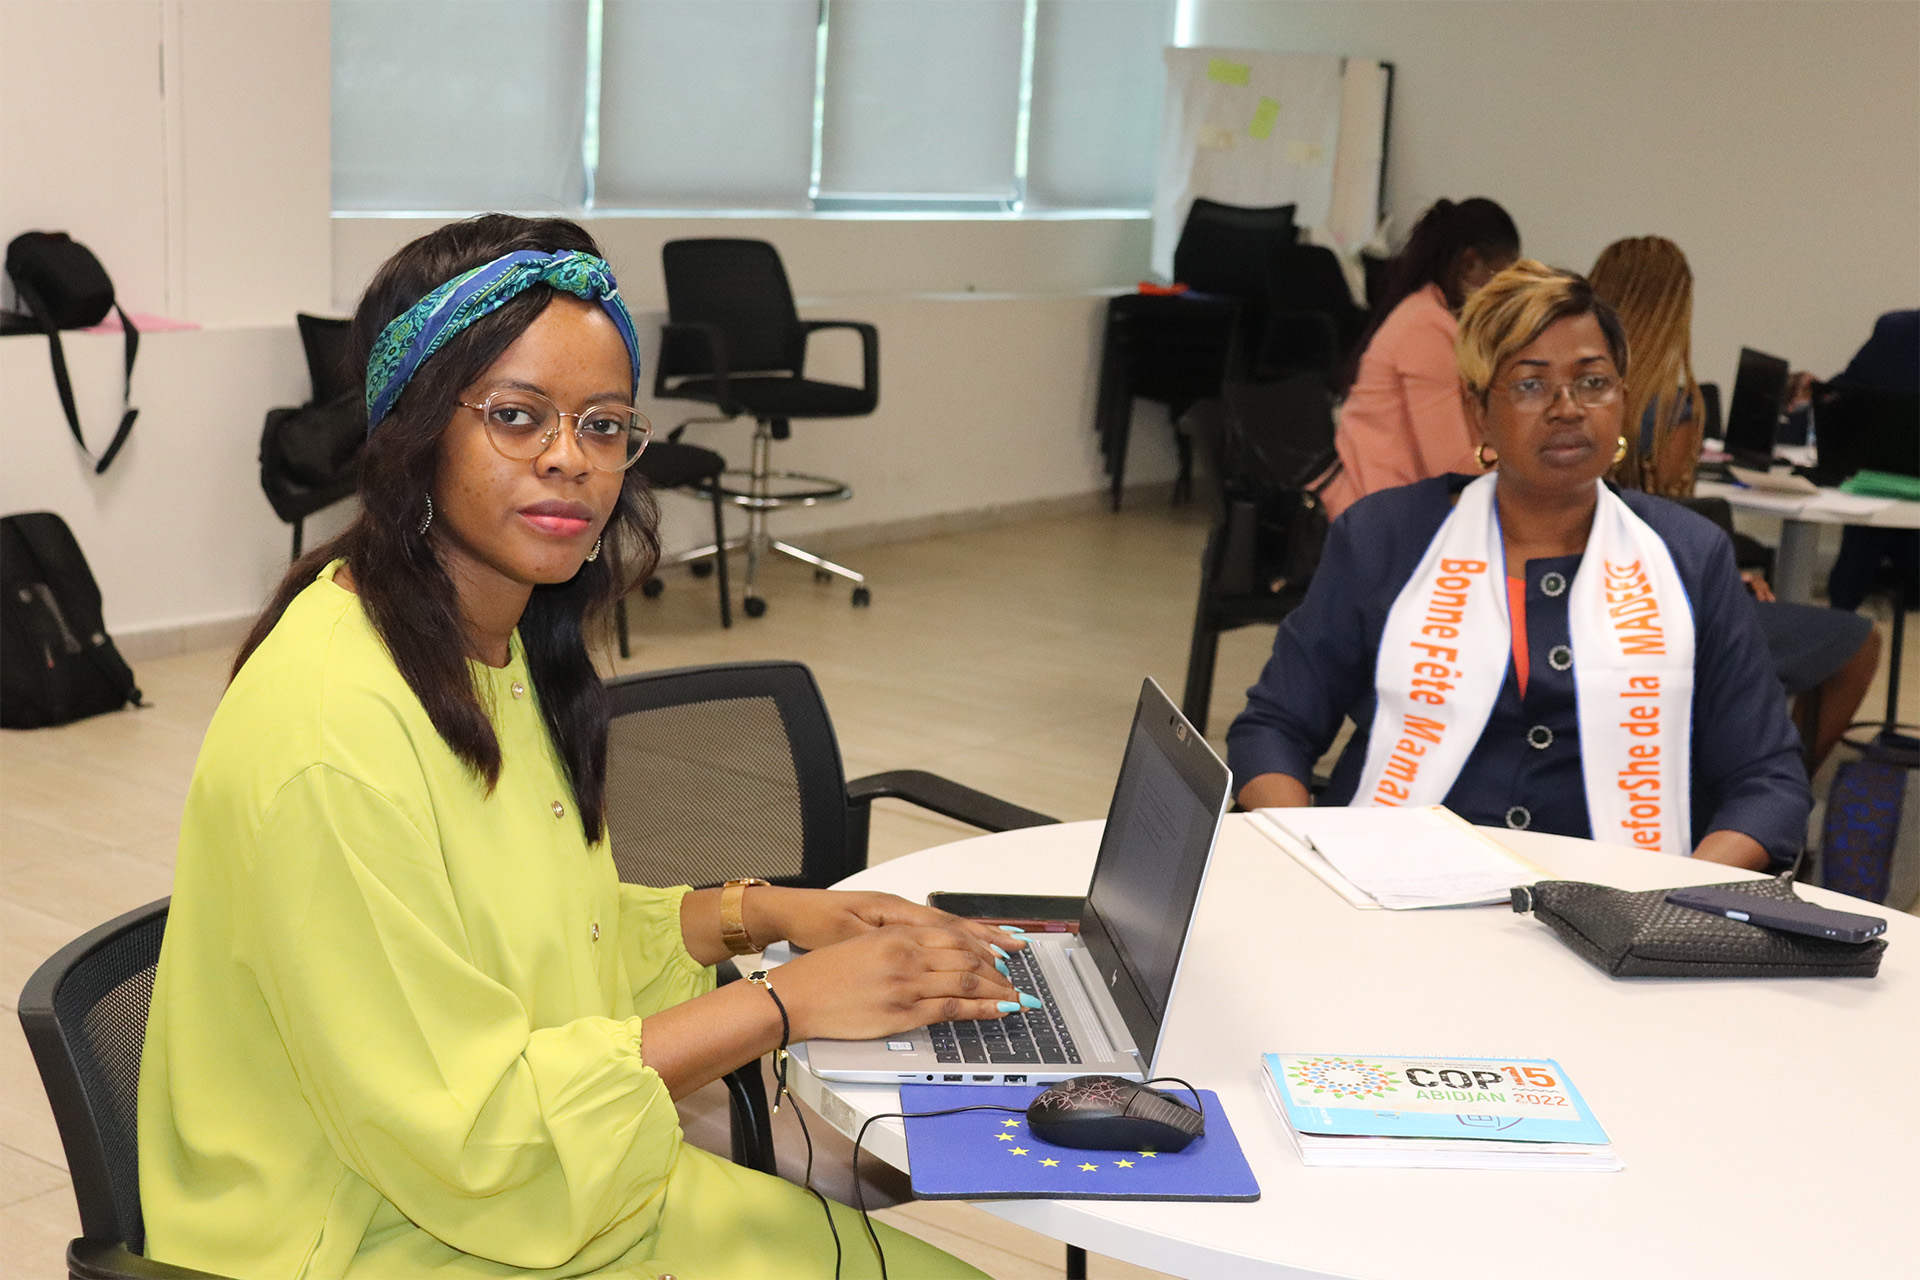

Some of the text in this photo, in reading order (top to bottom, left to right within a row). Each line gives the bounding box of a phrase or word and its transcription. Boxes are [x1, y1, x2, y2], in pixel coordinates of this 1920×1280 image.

[1421, 557, 1489, 640] Bonne
[1409, 641, 1463, 706] Fête
[1619, 676, 1661, 699] la
[1619, 705, 1661, 738] de
[1416, 1090, 1569, 1107] ABIDJAN 2022
